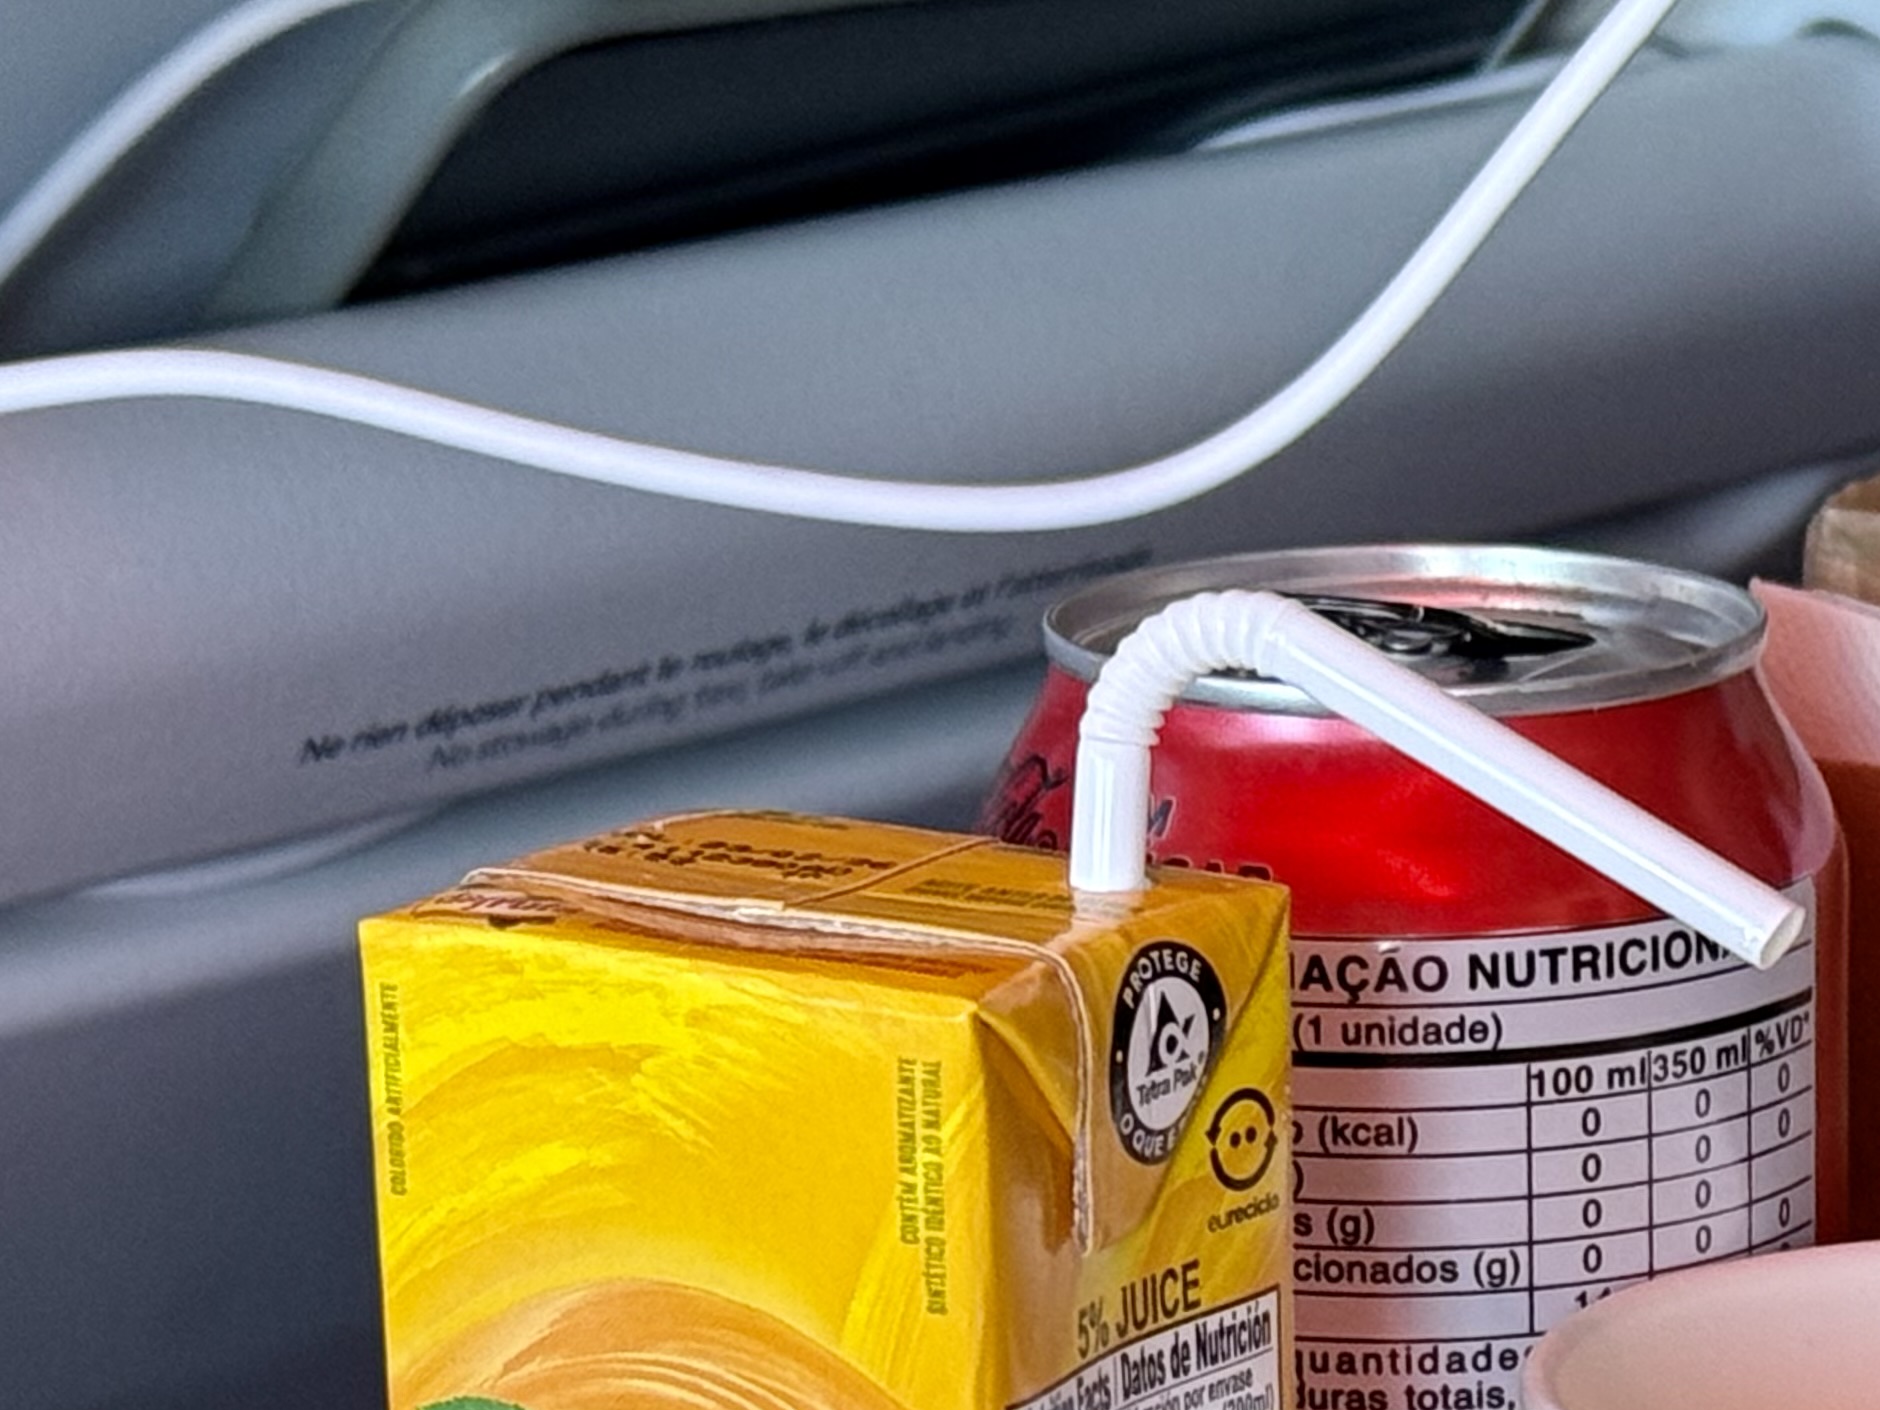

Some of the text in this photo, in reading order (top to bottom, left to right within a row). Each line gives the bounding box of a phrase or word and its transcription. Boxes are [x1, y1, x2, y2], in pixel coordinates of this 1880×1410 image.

[1121, 945, 1203, 1009] PROTEGE
[1289, 928, 1731, 1002] AÇÃO NUTRICION
[1341, 1011, 1503, 1050] unidade)
[1136, 1064, 1197, 1107] Tetra Pak
[1532, 1066, 1593, 1098] 100
[1608, 1057, 1647, 1090] ml
[1653, 1050, 1706, 1083] 350
[1716, 1035, 1748, 1069] ml
[1120, 1113, 1134, 1136] O
[1132, 1129, 1165, 1158] QUE
[1318, 1063, 1791, 1153] (kcal) 0 0 0
[1582, 1109, 1791, 1183] 0 0 0
[1207, 1192, 1280, 1234] eureciclo
[1327, 1180, 1711, 1247] (g) 0 0
[1474, 1250, 1521, 1289] (g)
[1582, 1244, 1602, 1274] 0
[1696, 1225, 1711, 1255] 0
[1777, 1199, 1791, 1228] 0
[1077, 1258, 1201, 1359] 5% JUICE
[1120, 1346, 1166, 1401] Datos
[1170, 1331, 1190, 1379] de
[1195, 1300, 1272, 1371] Nutrición
[1295, 1343, 1533, 1380] uantidade
[1208, 1367, 1253, 1401] envase
